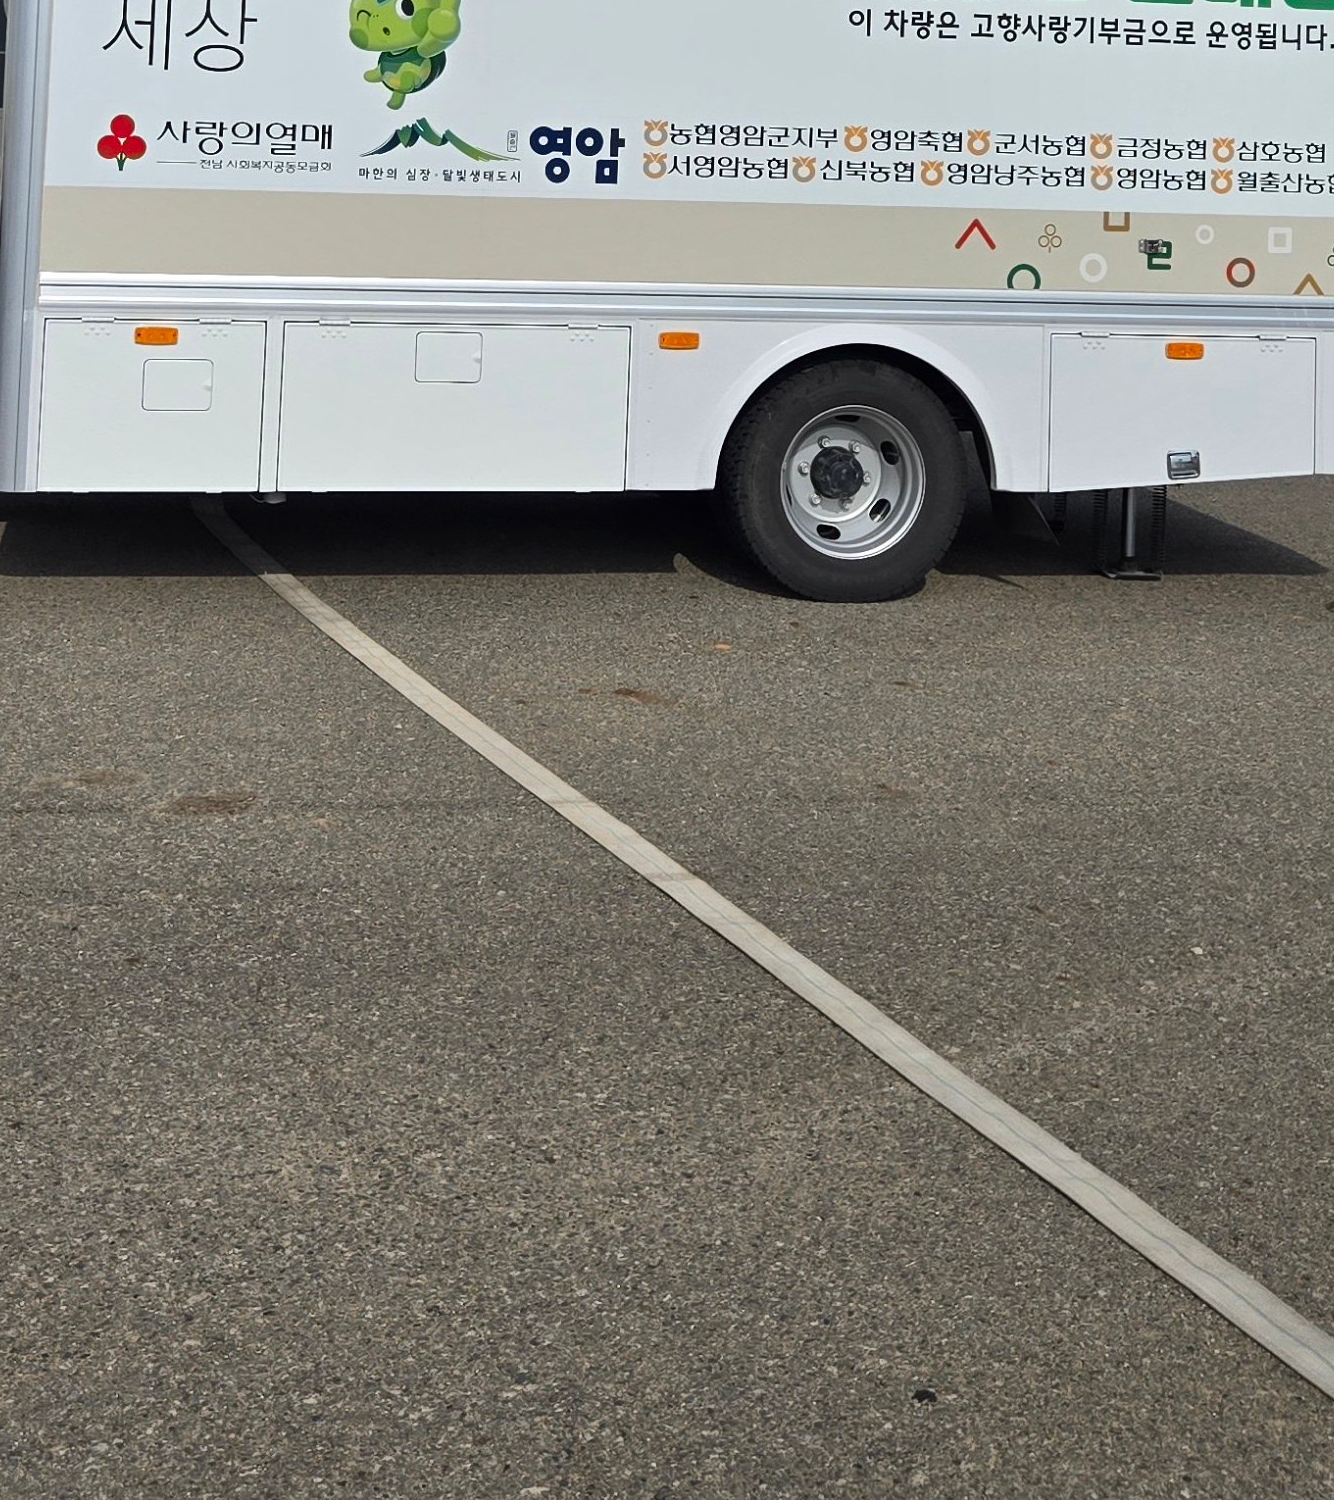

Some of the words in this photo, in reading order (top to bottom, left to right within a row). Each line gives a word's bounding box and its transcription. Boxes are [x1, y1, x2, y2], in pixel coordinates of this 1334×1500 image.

[848, 9, 873, 37] 이
[884, 10, 961, 40] 차량은
[970, 12, 1197, 47] 고향사랑기부금으로
[156, 120, 333, 156] 사랑의열매
[529, 125, 626, 185] 영암
[669, 123, 838, 149] 농협영암군지부
[870, 129, 963, 154] 영암축협
[994, 133, 1086, 157] 군서농협
[1117, 136, 1207, 161] 금정농협
[1236, 141, 1327, 165] 삼호농협
[358, 167, 398, 180] 마한의
[667, 155, 788, 180] 서영암농협
[820, 159, 915, 183] 신북농협
[947, 161, 1085, 188] 영암낭주농협
[1117, 168, 1207, 192] 영암농협
